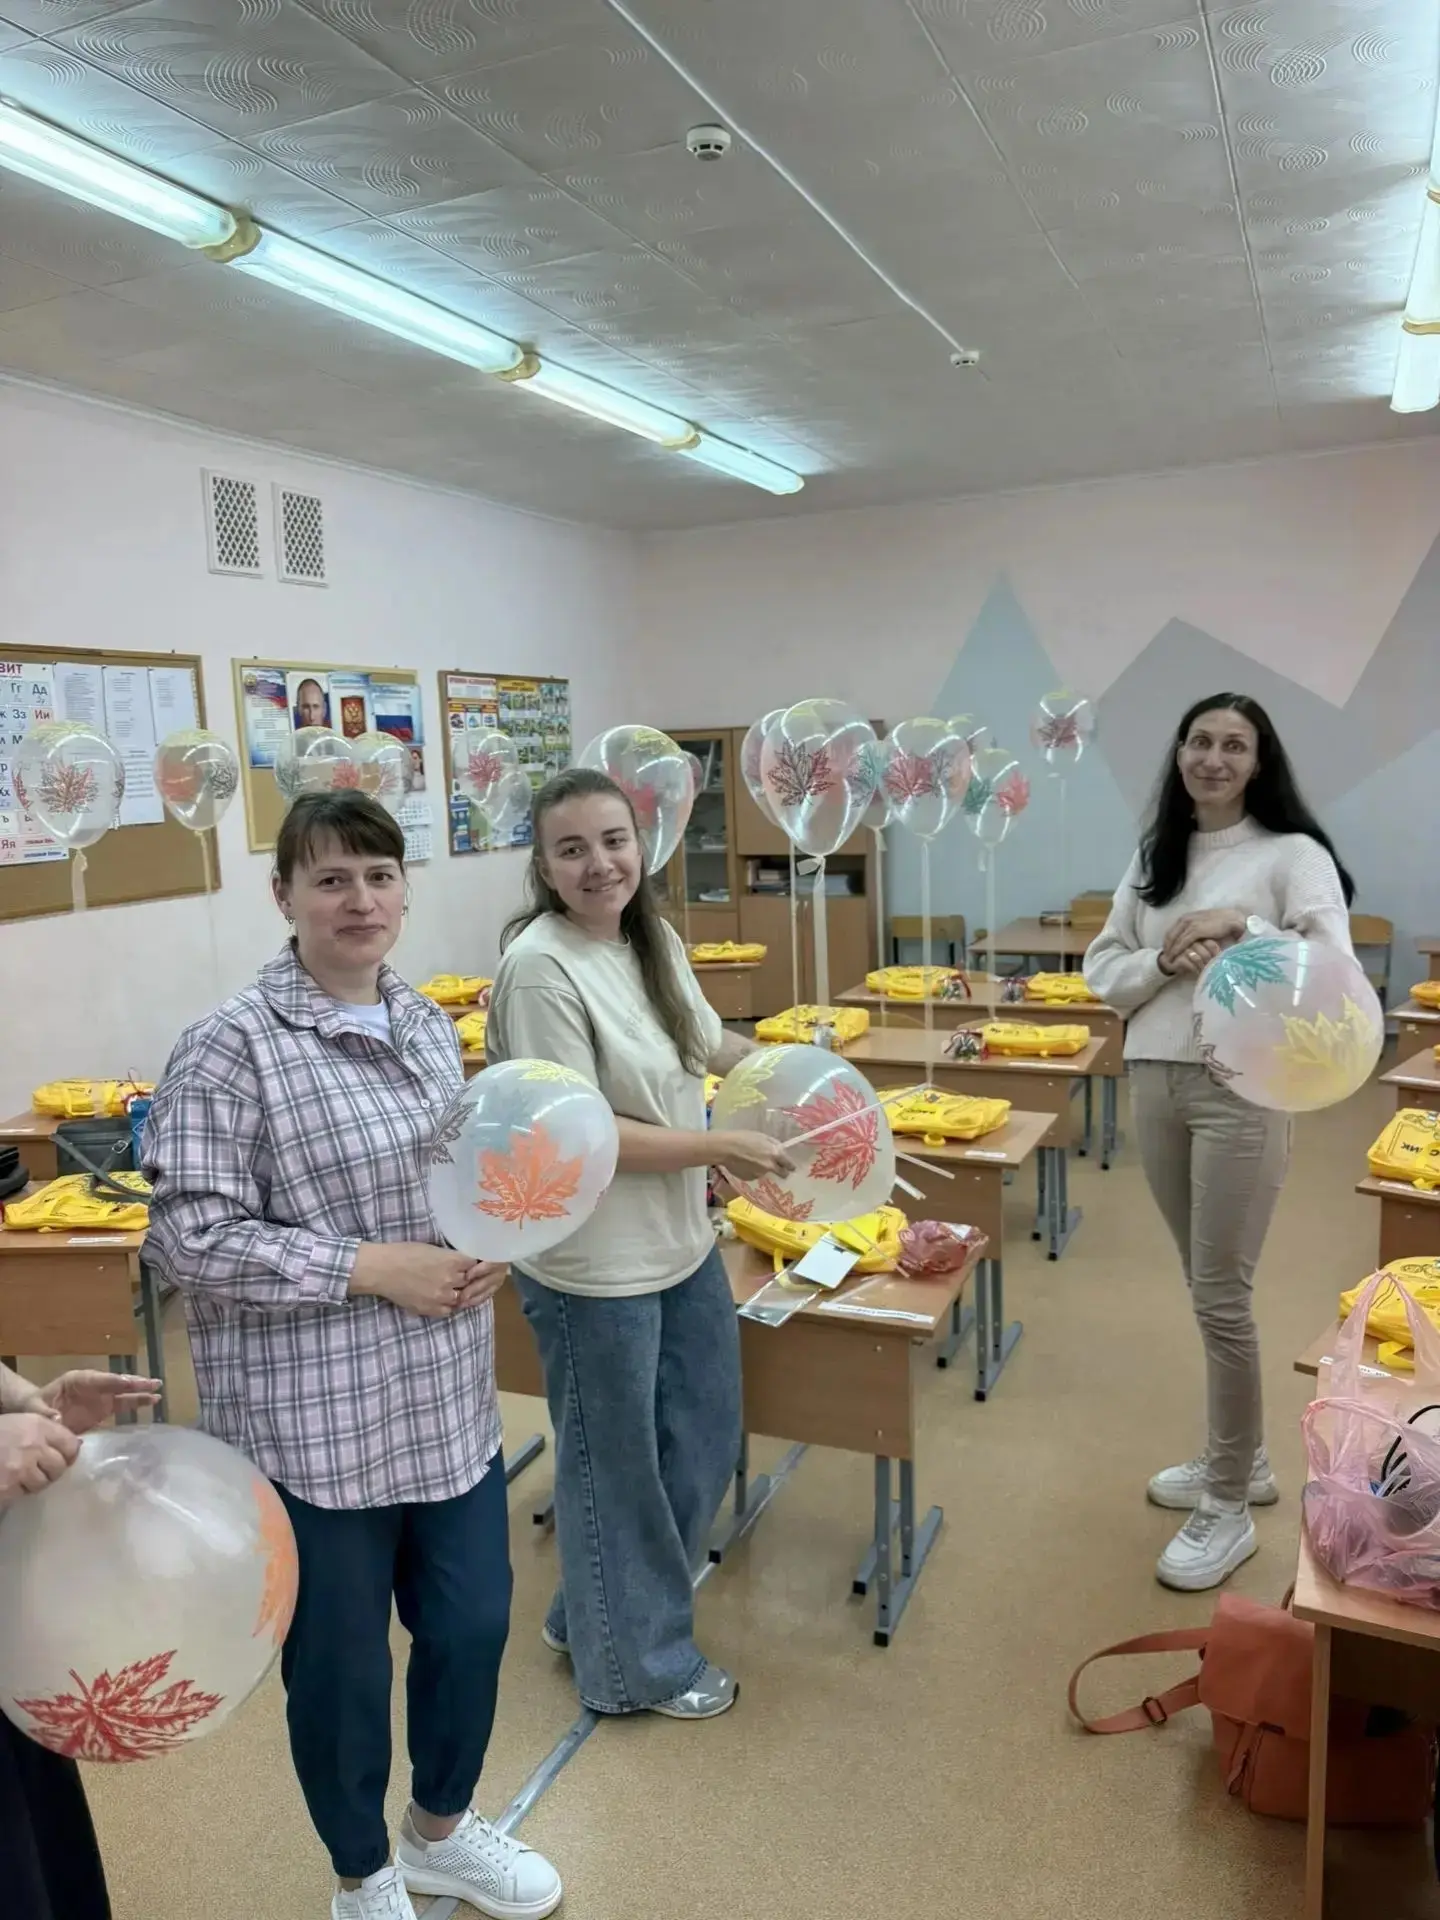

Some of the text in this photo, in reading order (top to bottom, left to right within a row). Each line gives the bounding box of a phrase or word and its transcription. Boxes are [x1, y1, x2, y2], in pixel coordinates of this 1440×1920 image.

[32, 684, 48, 696] Дд
[12, 708, 27, 719] Зз
[35, 709, 50, 720] Ии
[2, 839, 16, 849] Яя
